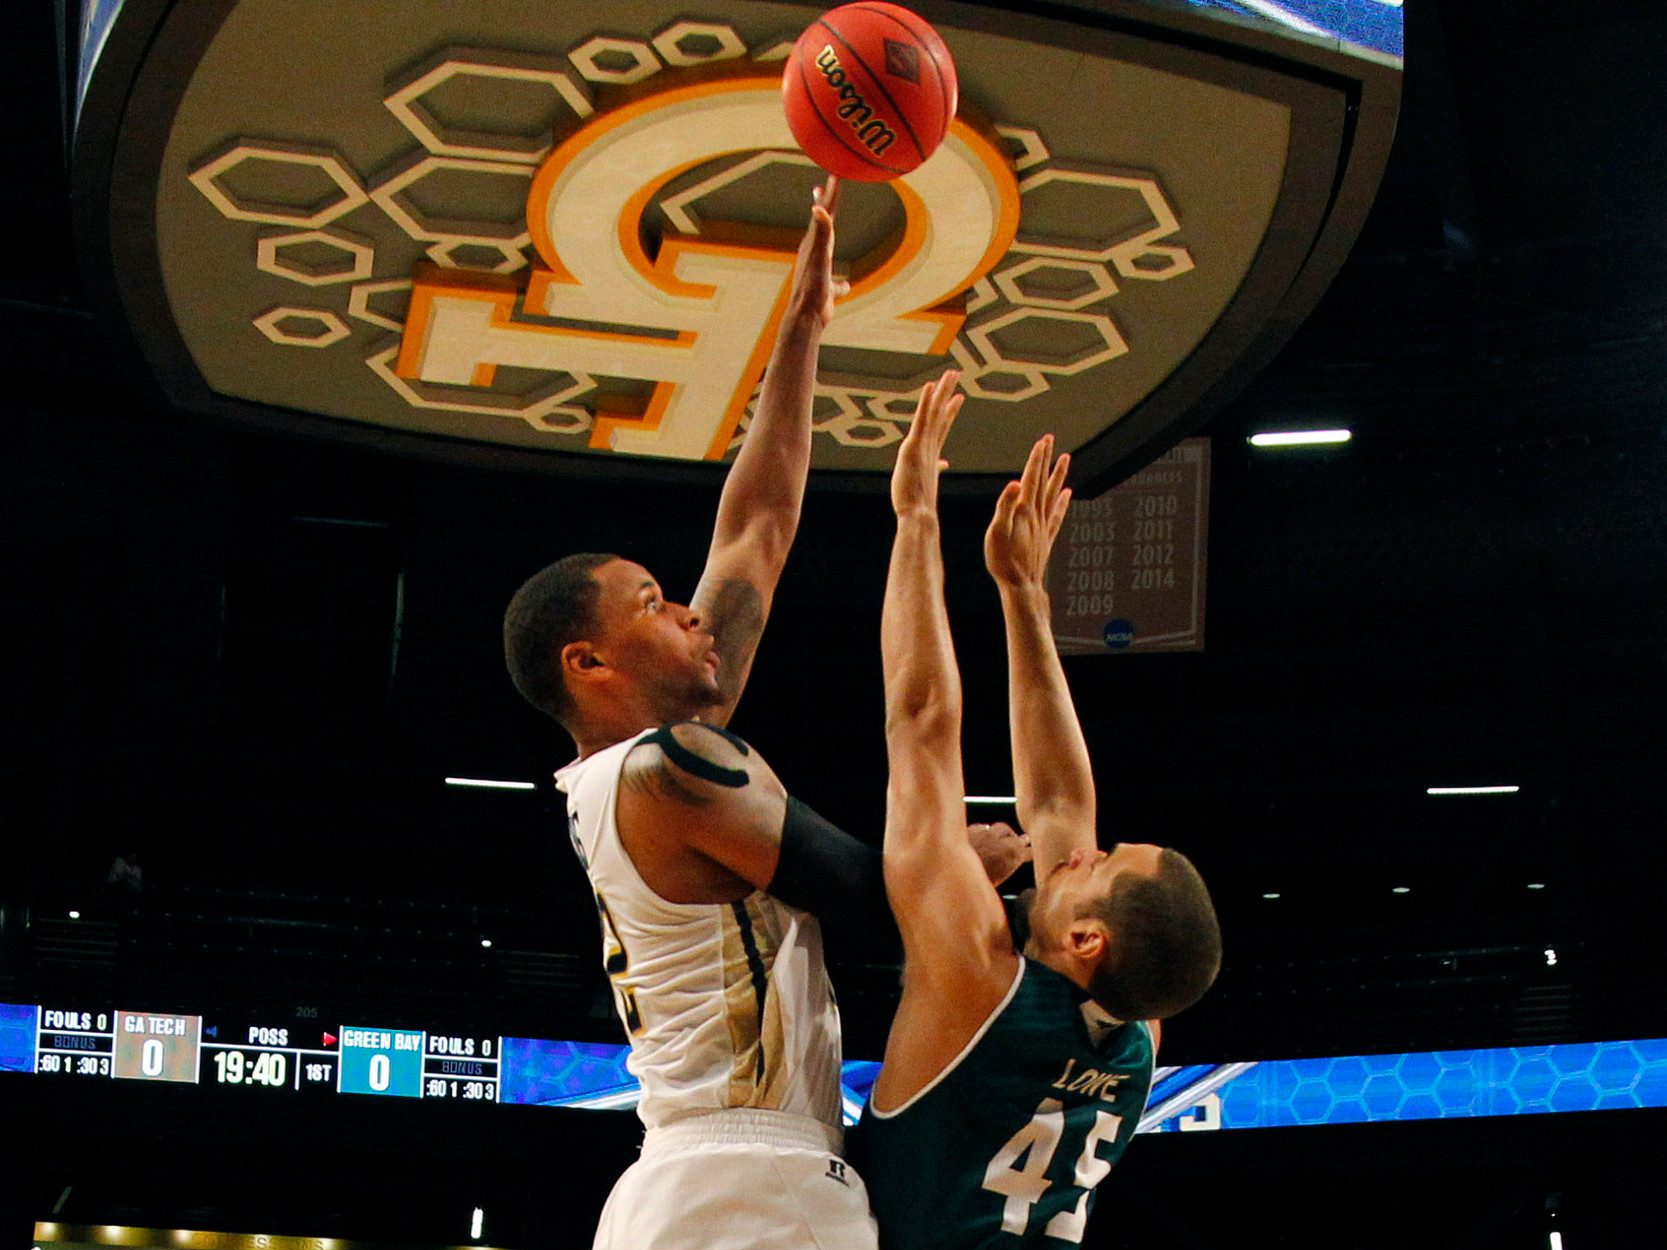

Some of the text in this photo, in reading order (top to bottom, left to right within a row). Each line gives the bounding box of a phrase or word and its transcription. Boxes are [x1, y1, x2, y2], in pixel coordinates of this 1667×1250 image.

[815, 44, 897, 158] Wilson
[1133, 495, 1178, 518] 2010
[1069, 521, 1116, 544] 2003
[1132, 519, 1174, 541] 2011
[1068, 546, 1115, 568] 2007
[1131, 543, 1175, 565] 2012
[1067, 570, 1115, 592] 2008
[1130, 567, 1175, 590] 2014
[1065, 594, 1114, 617] 2009
[45, 1010, 107, 1031] FOULS 0
[296, 1006, 318, 1018] 205
[125, 1016, 186, 1036] GA TECH
[249, 1026, 289, 1046] POSS
[54, 1035, 96, 1049] BONUS
[344, 1030, 421, 1051] GREEN BAY
[429, 1035, 491, 1056] FOULS 0
[64, 1056, 72, 1073] 1
[100, 1058, 109, 1075] 3
[142, 1039, 164, 1077] 0
[213, 1050, 287, 1086] 19:40
[442, 1061, 483, 1075] BONUS
[305, 1063, 332, 1081] 1ST
[369, 1054, 391, 1091] 0
[1052, 1058, 1132, 1102] LOWE
[450, 1081, 458, 1098] 1
[485, 1083, 494, 1100] 3
[981, 1097, 1123, 1244] 45
